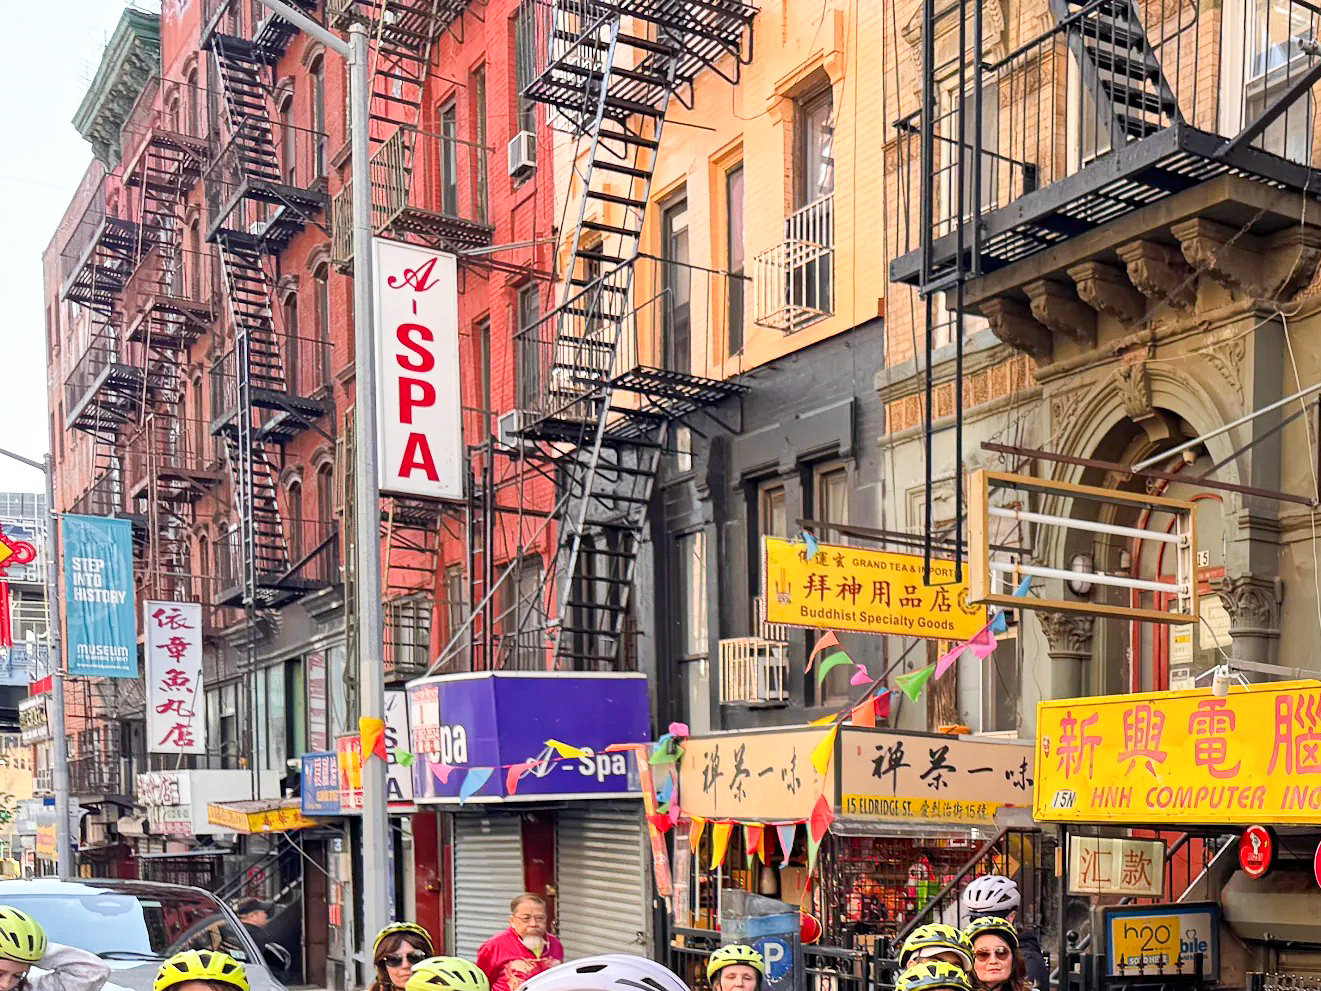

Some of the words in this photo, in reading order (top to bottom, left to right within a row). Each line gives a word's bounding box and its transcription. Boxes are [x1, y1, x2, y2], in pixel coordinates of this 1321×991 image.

[72, 557, 105, 572] STEP
[852, 558, 887, 570] GRAND
[890, 562, 908, 573] TEA
[910, 565, 916, 573] &
[1197, 553, 1209, 566] 15
[73, 573, 103, 588] INTO
[73, 588, 127, 605] HISTORY
[803, 572, 952, 613] 拜神用品店
[800, 606, 857, 623] Buddhist
[859, 612, 915, 629] Specialty
[917, 618, 954, 631] Goods
[1091, 786, 1133, 809] HNH
[1145, 785, 1267, 810] COMPUTER
[847, 797, 857, 815] 15
[859, 797, 899, 817] ELDRIDGE
[902, 801, 913, 817] ST.
[1080, 847, 1152, 887] 汇款
[764, 941, 786, 976] P
[1129, 956, 1148, 965] SOD
[1149, 954, 1168, 963] HEE
